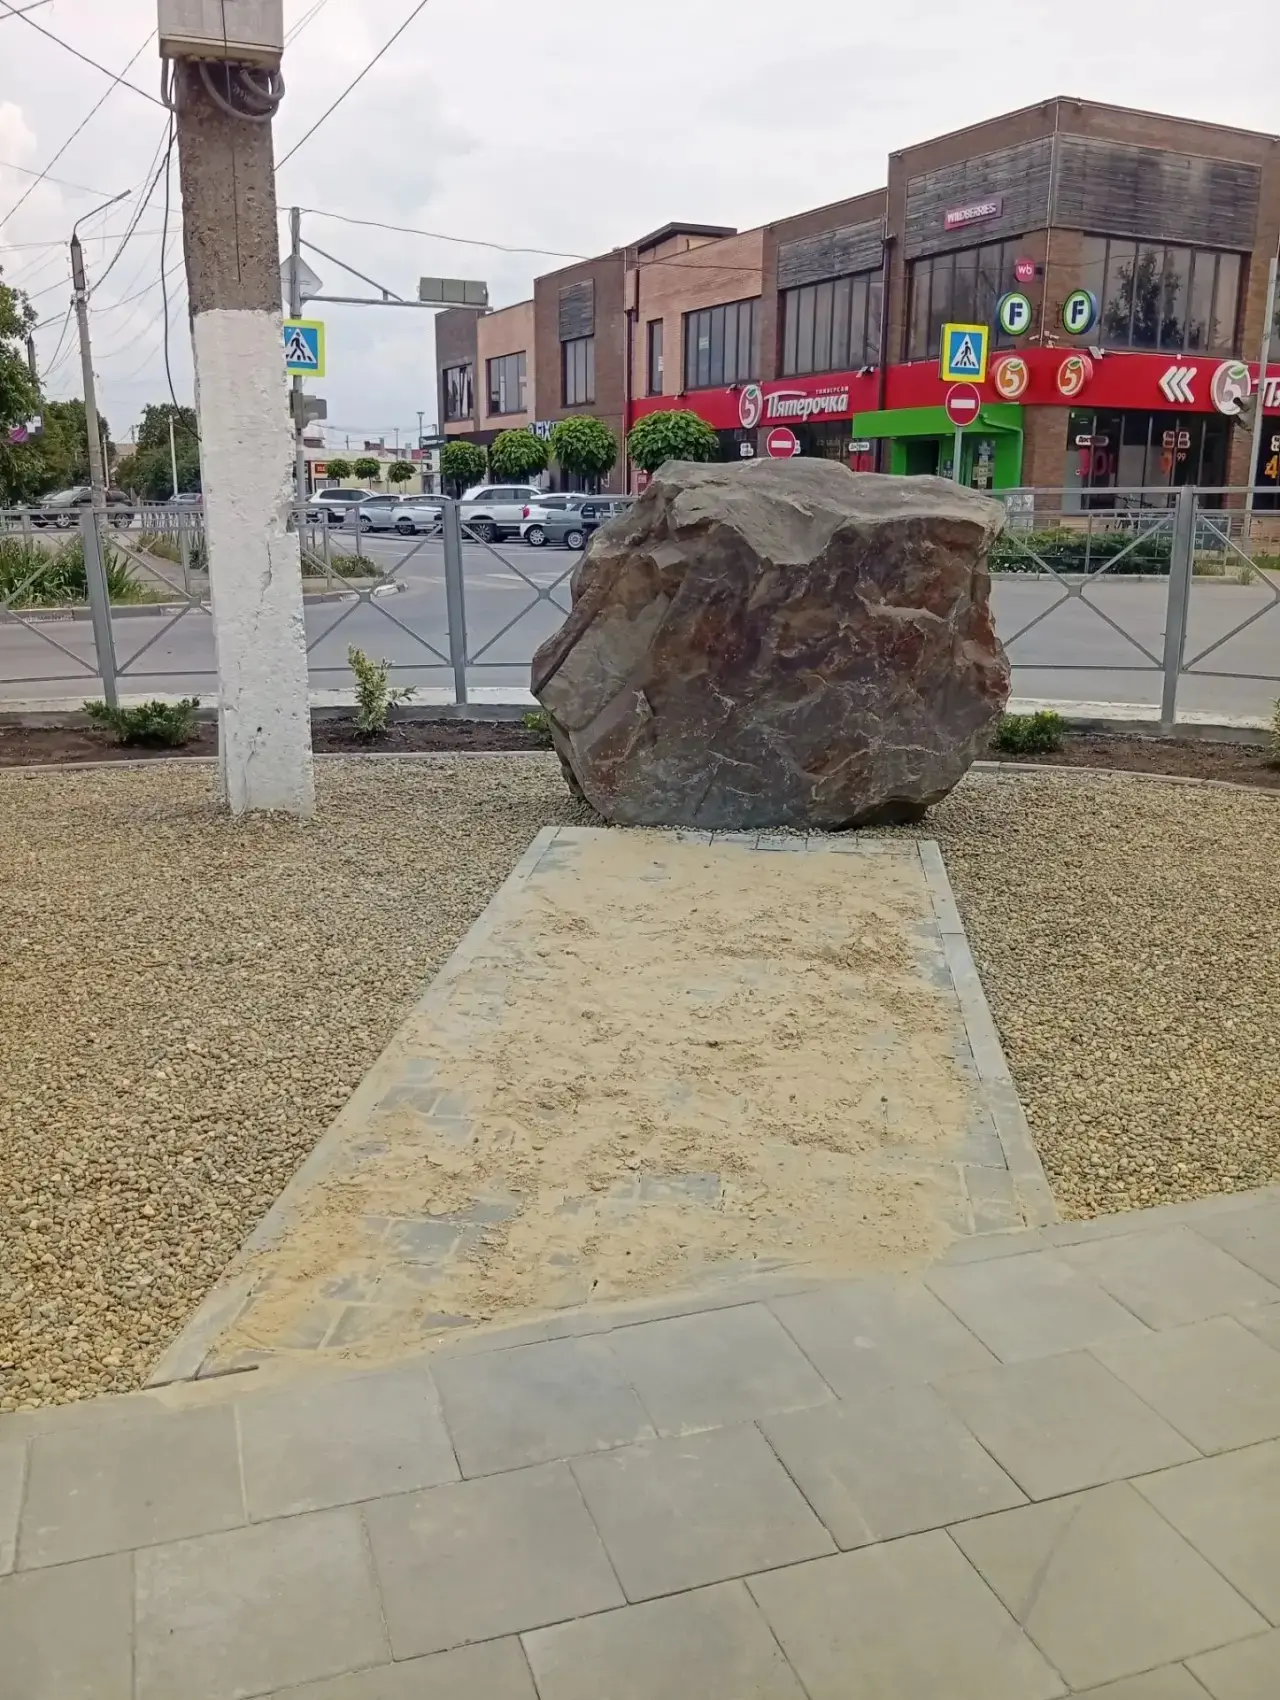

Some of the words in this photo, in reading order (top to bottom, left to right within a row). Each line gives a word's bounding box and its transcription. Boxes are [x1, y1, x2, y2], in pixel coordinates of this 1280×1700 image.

[947, 202, 996, 223] WILDBERRIES
[1018, 264, 1033, 276] wb
[1009, 302, 1023, 326] F
[1071, 300, 1085, 325] F
[763, 390, 849, 421] Пятерочка
